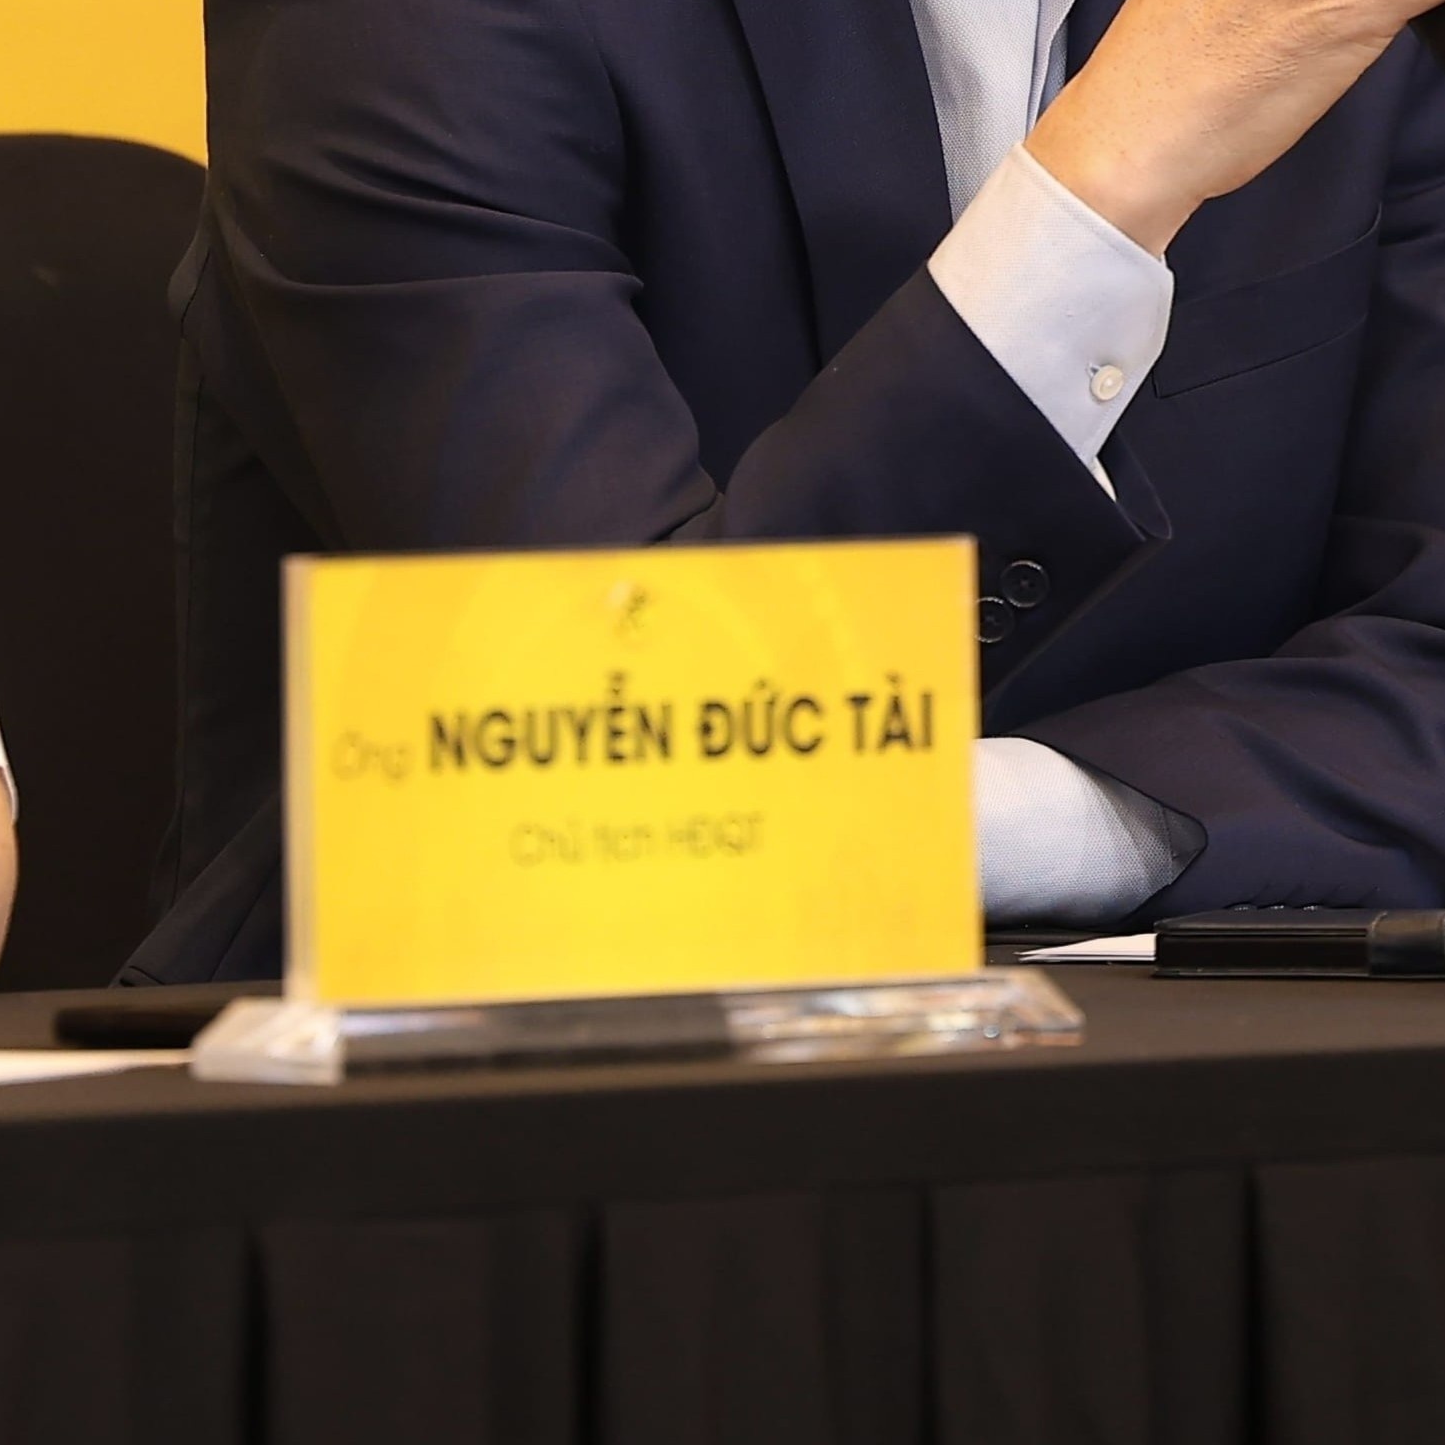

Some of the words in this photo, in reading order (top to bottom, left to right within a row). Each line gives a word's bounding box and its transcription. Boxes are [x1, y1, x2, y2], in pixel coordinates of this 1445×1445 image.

[429, 671, 672, 772] NGUYỄN
[698, 678, 824, 758] ĐỨC
[845, 673, 934, 752] TÀI
